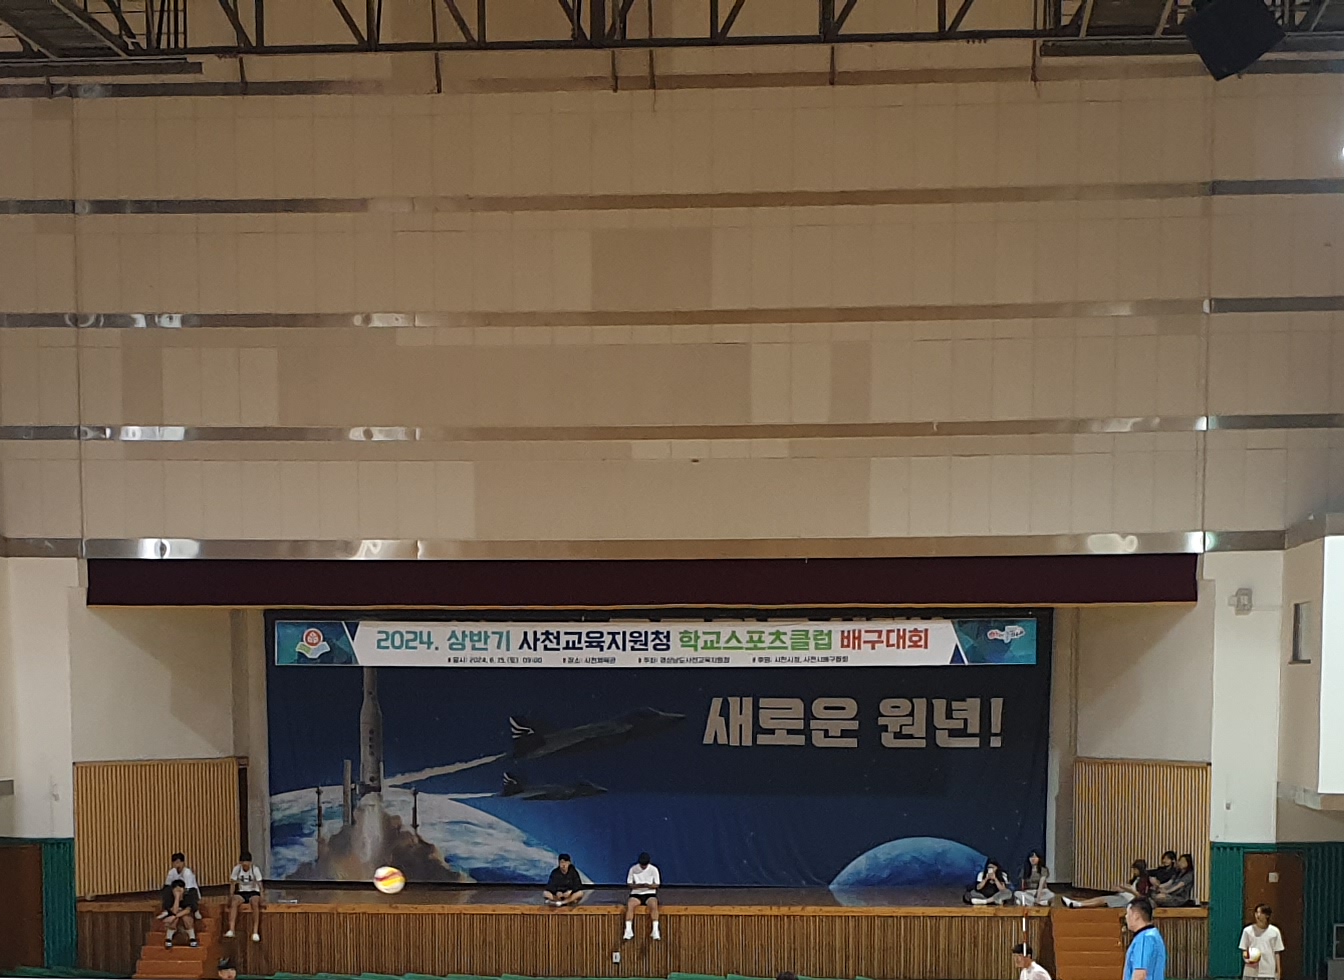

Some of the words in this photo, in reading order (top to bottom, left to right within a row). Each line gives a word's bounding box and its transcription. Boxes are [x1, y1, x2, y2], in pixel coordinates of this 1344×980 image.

[376, 630, 439, 651] 2024.
[447, 630, 511, 651] 상반기
[518, 629, 671, 652] 사천교육지원청
[678, 629, 833, 652] 학교스포츠클럽
[840, 627, 929, 651] 배구대회
[703, 697, 858, 748] 새로운
[878, 698, 1003, 748] 원년!
